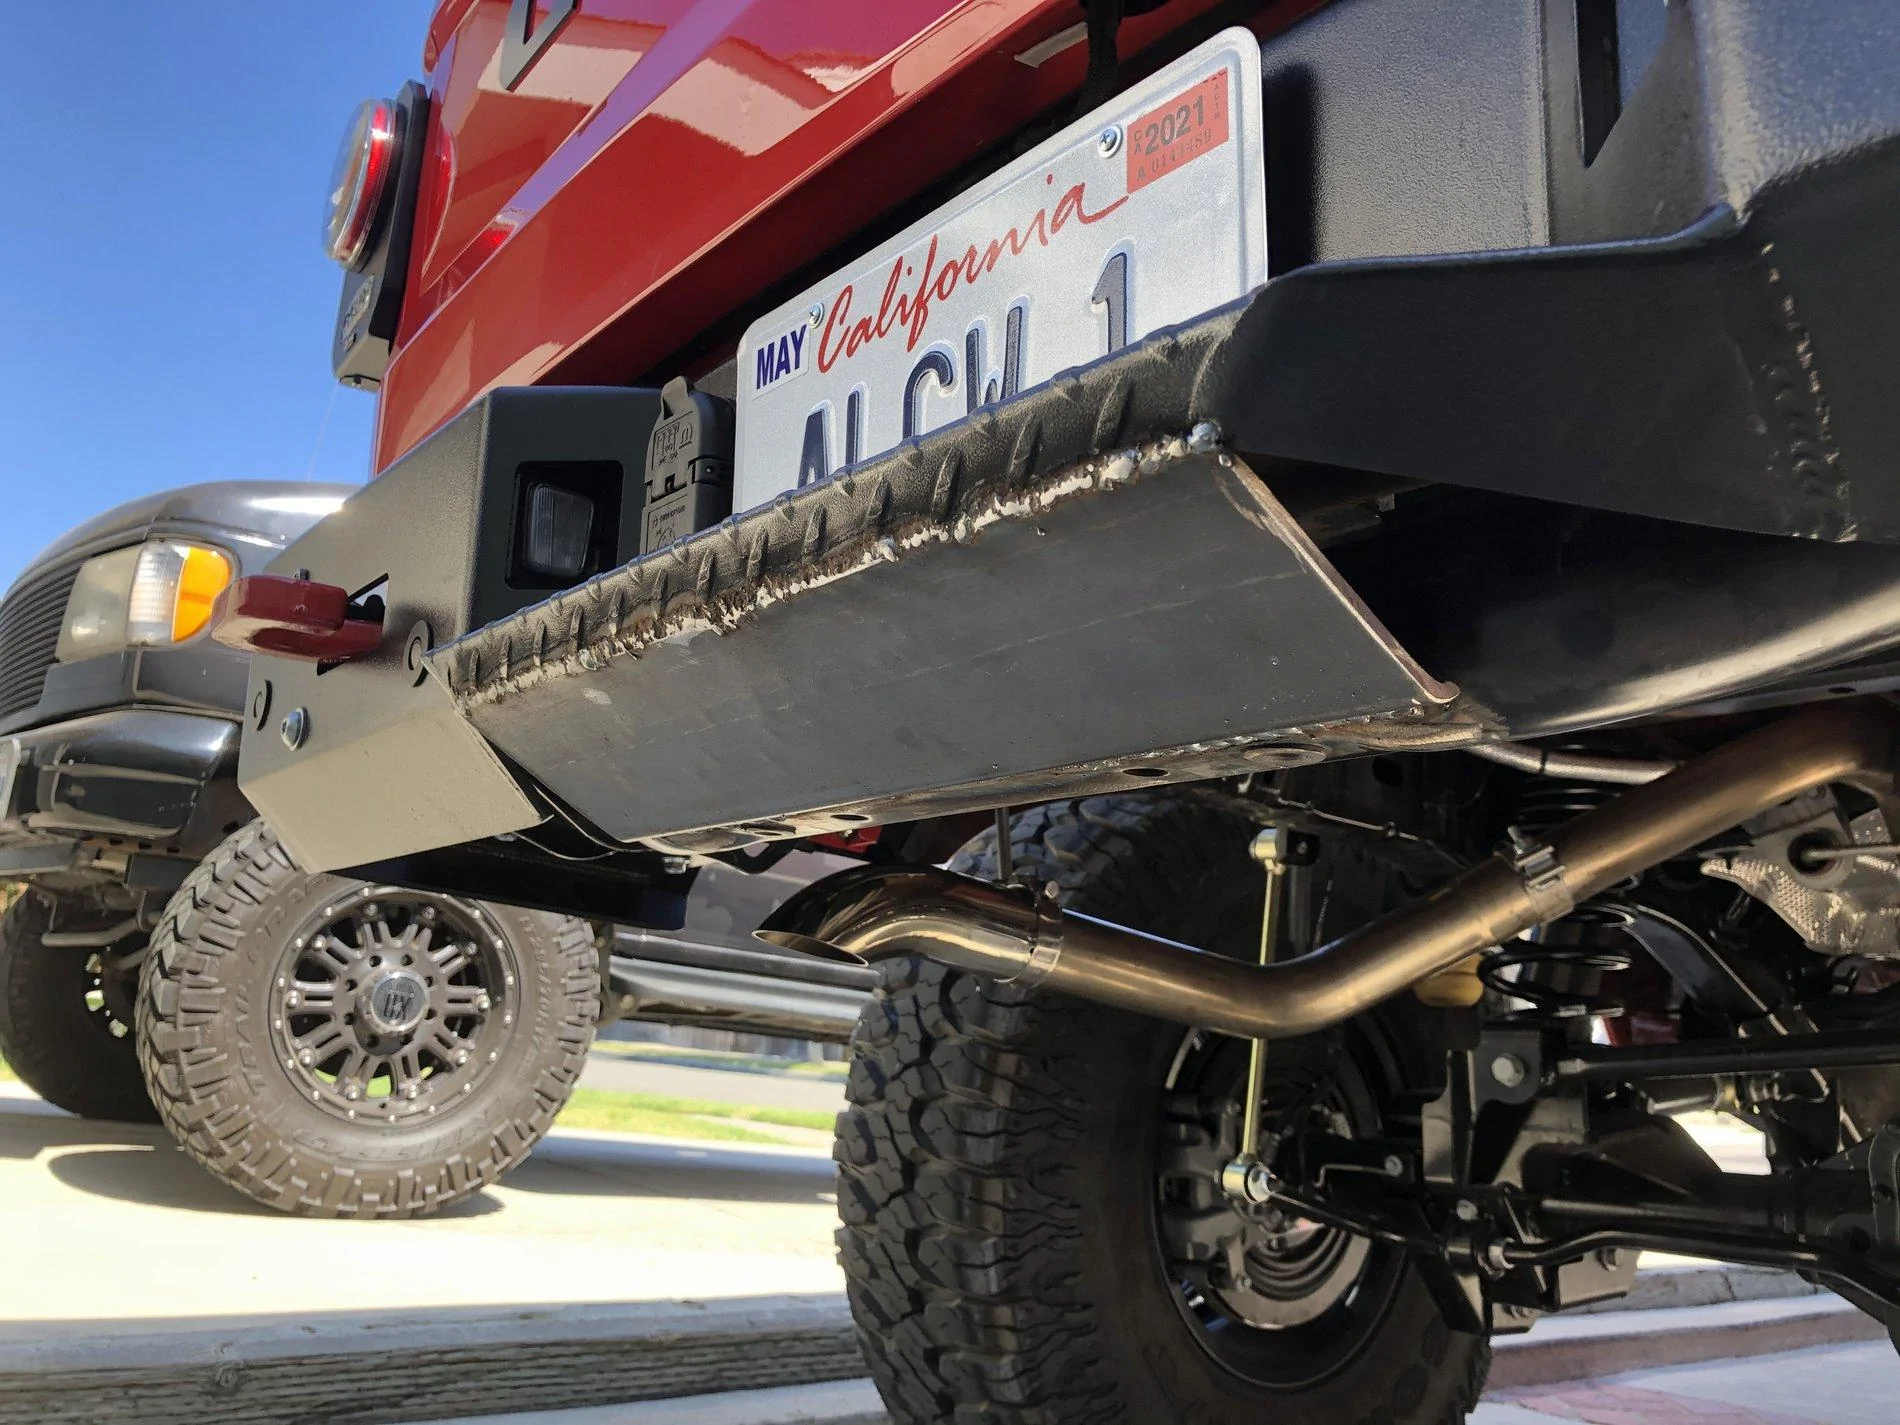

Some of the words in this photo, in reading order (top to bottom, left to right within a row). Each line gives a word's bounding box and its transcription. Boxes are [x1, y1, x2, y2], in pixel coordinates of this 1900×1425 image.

[1145, 94, 1204, 156] 2021
[816, 173, 1130, 373] California
[756, 324, 808, 390] MAY
